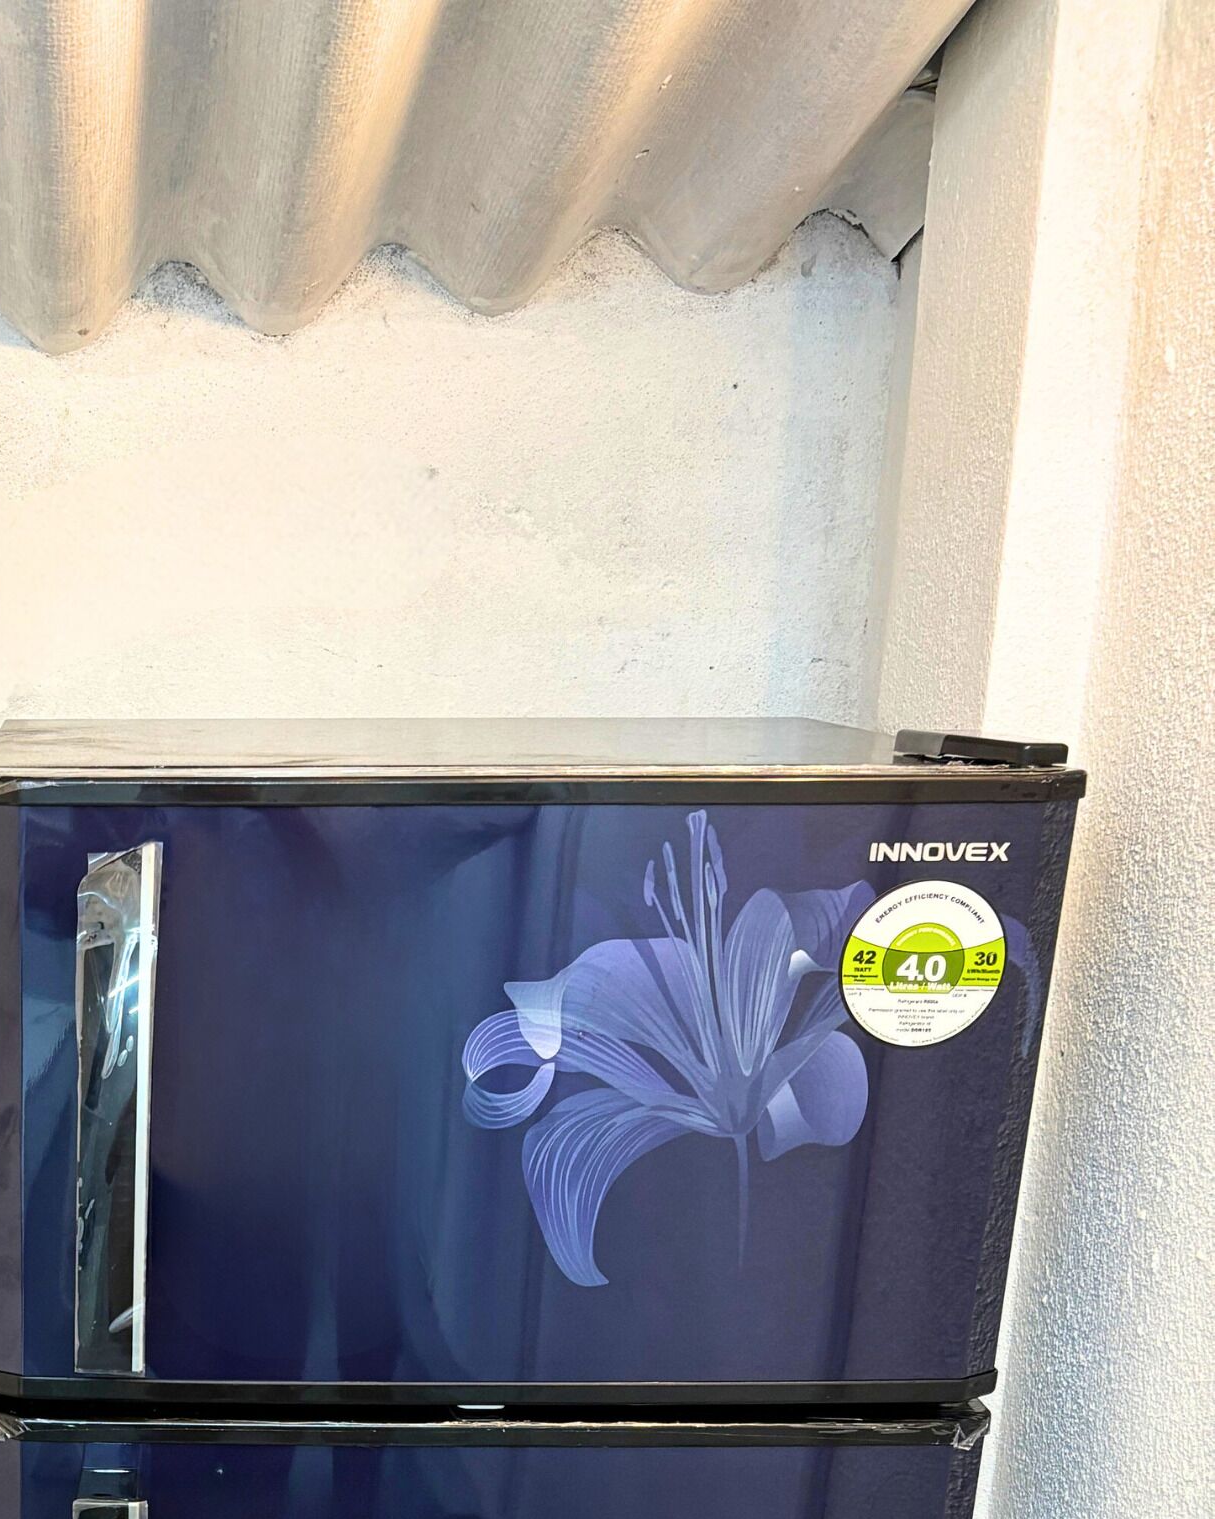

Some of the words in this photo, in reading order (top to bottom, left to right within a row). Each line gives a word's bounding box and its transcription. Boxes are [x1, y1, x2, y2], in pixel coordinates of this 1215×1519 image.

[868, 842, 1011, 862] INNOVEX
[875, 900, 902, 923] ENERGY
[904, 893, 949, 904] EFFICIENCY
[950, 896, 985, 924] COMPLIANT
[853, 950, 877, 964] 42
[974, 951, 997, 966] 30
[896, 954, 947, 981] 4.0
